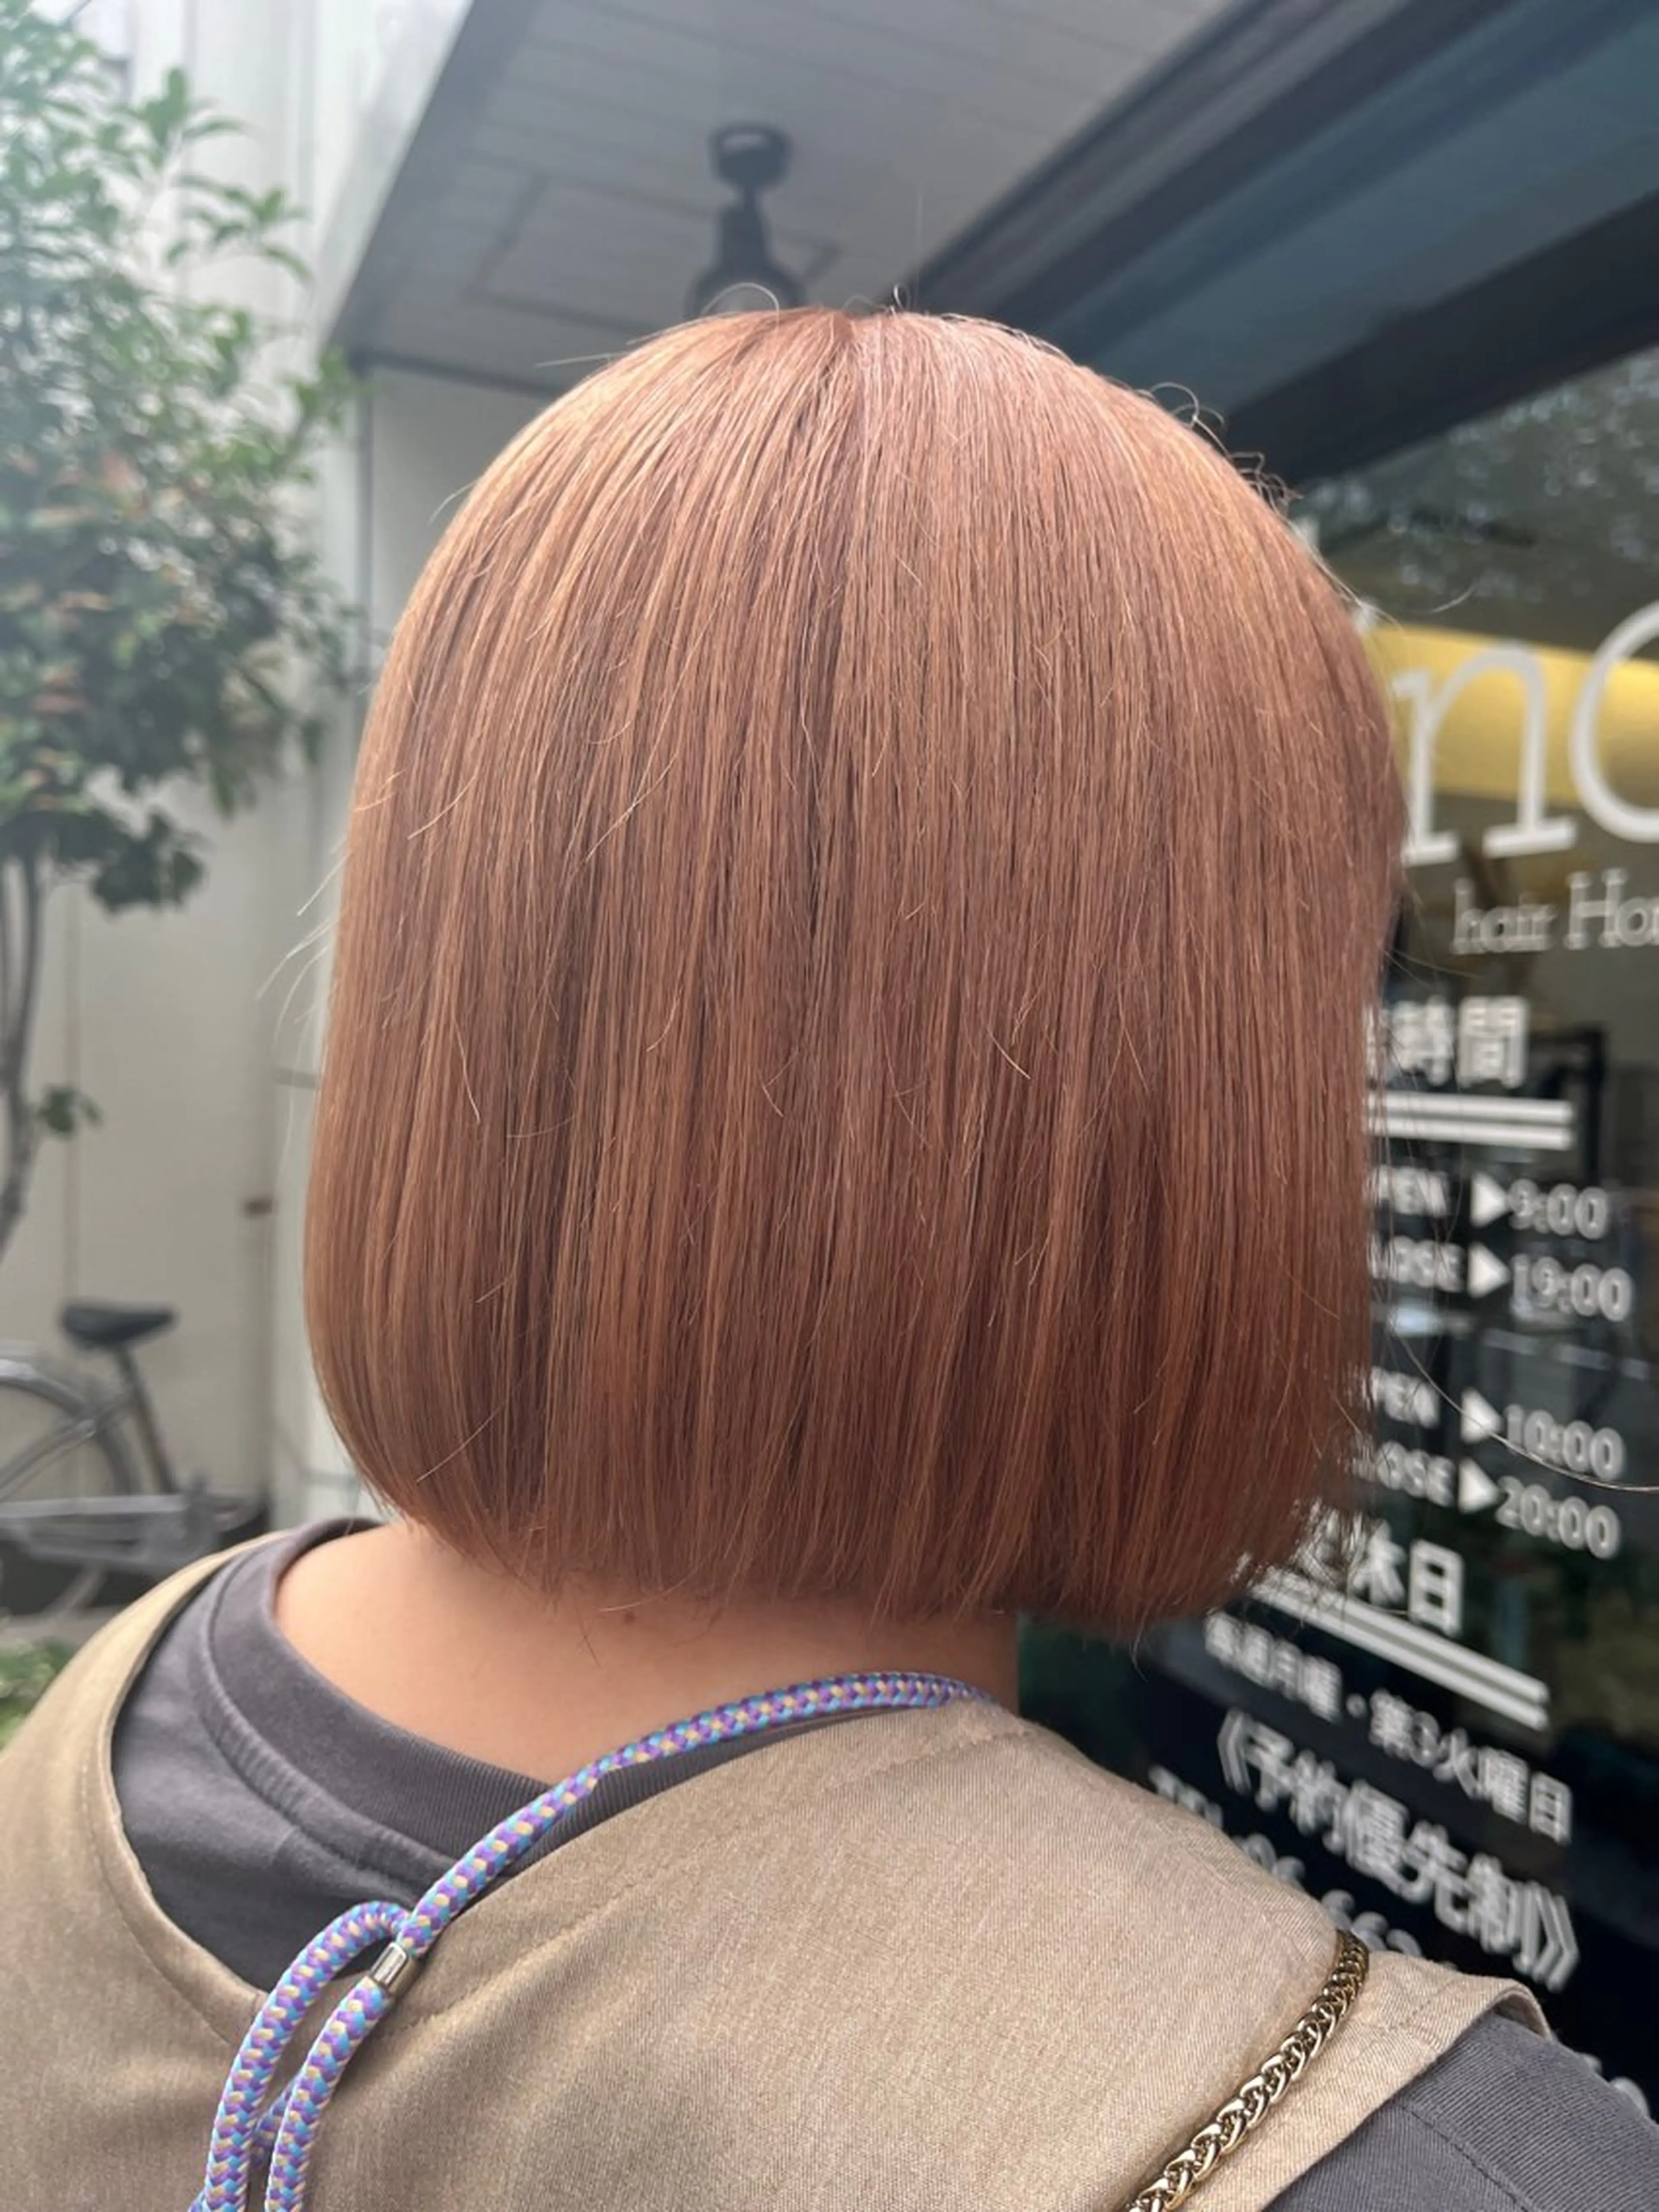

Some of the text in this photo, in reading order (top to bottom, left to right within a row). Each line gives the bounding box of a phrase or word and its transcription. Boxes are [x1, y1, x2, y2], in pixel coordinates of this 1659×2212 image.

[1564, 868, 1659, 949] Ho
[1508, 1179, 1608, 1240] 9:00
[1511, 1254, 1633, 1322] 19:00
[1504, 1403, 1625, 1481] 10:00
[1495, 1476, 1621, 1559] 20:00
